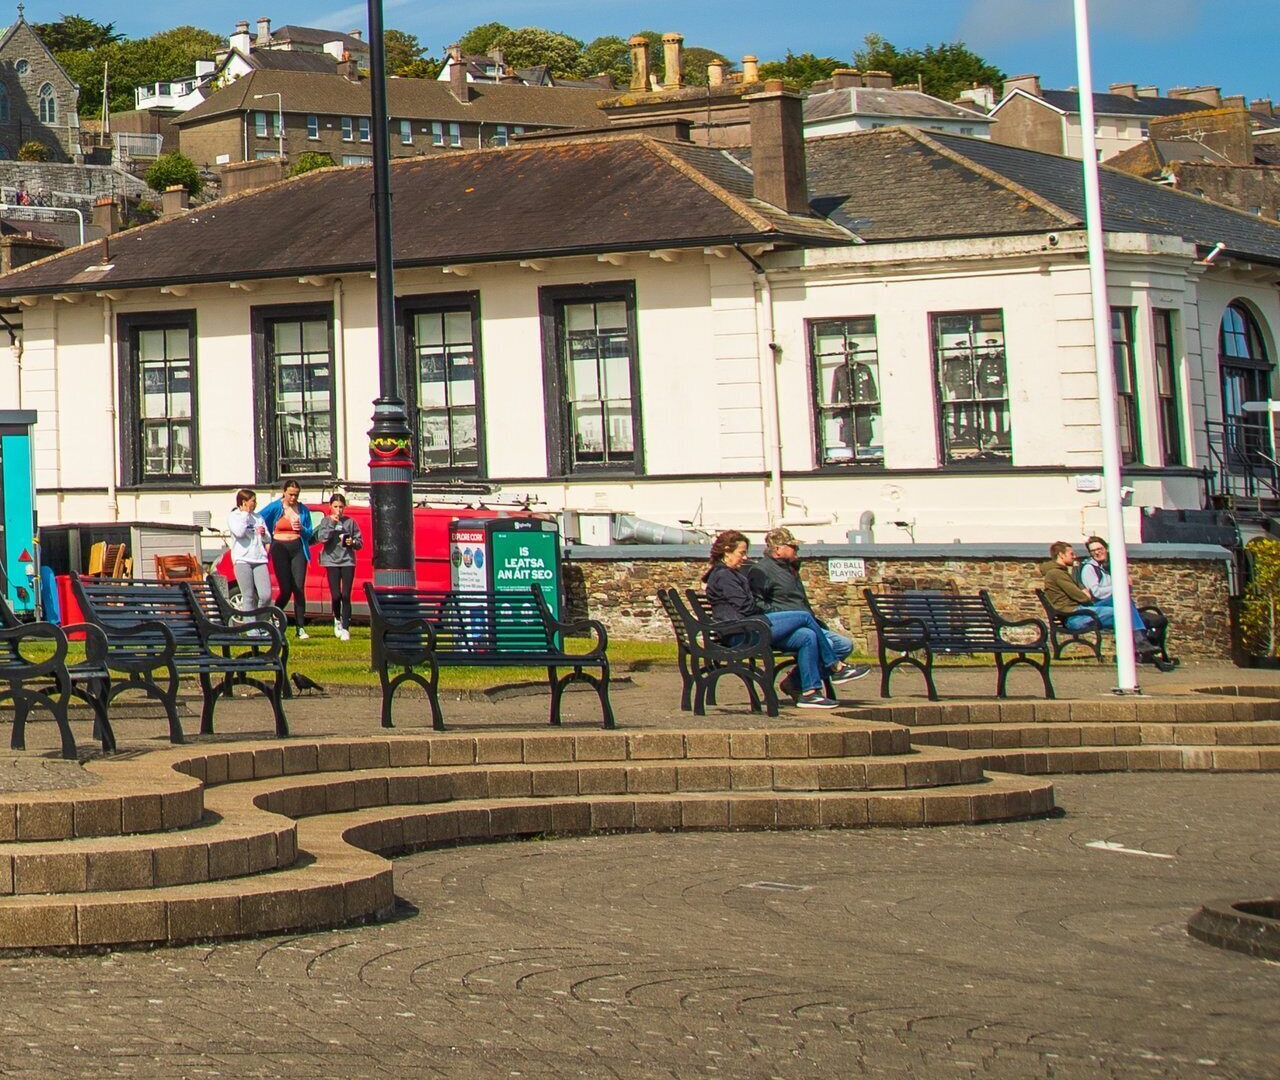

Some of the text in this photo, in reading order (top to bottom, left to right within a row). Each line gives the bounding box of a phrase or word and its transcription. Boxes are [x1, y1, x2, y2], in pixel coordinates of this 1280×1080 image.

[470, 533, 483, 541] CORK
[519, 546, 529, 556] IS
[505, 558, 545, 568] LEATSA
[498, 567, 553, 579] AN ÁIT SEO
